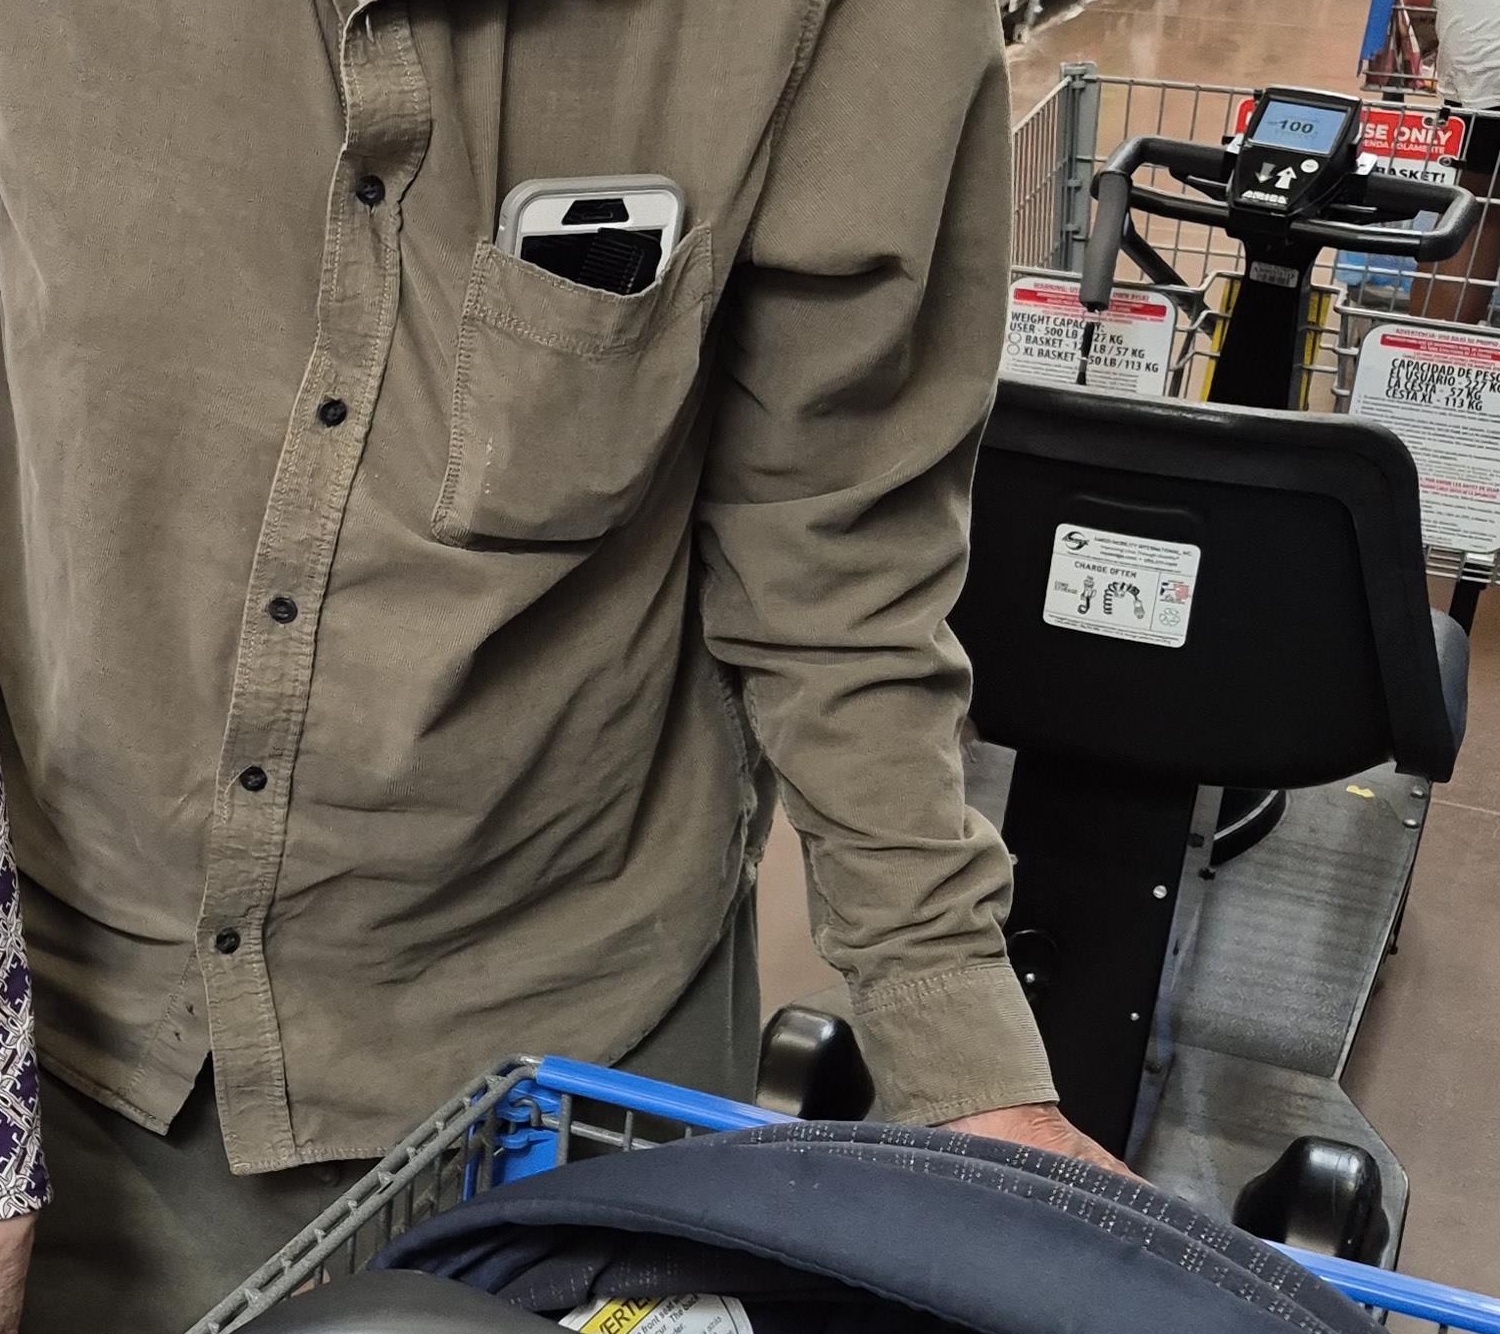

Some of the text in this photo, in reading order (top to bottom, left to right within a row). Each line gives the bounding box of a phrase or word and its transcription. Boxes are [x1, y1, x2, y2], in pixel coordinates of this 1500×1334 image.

[1280, 119, 1314, 134] 100
[1363, 123, 1453, 145] SE ONLY
[1373, 166, 1446, 184] BASKET!
[1010, 322, 1124, 345] USER 500 LB 27 KG
[1011, 311, 1105, 334] WEIGHT CAPACY:
[1025, 332, 1063, 348] BASKET
[1093, 344, 1106, 354] LB
[1116, 346, 1128, 357] 57
[1131, 348, 1146, 359] KG
[1023, 345, 1035, 357] XL
[1037, 348, 1075, 362] BASKET
[1088, 355, 1102, 365] 50
[1103, 356, 1118, 367] LB
[1124, 359, 1142, 371] 113
[1145, 362, 1160, 373] KG
[1391, 358, 1455, 376] CAPACIDAD
[1457, 367, 1473, 378] DE
[1387, 377, 1482, 401] LA CESTA 57 KG
[1389, 367, 1402, 379] EL
[1405, 369, 1456, 387] USUARIO
[1465, 377, 1486, 392] 227
[1385, 388, 1483, 412] CESTA XL 113 KG
[1074, 560, 1106, 573] CHARGE
[669, 1308, 685, 1324] The
